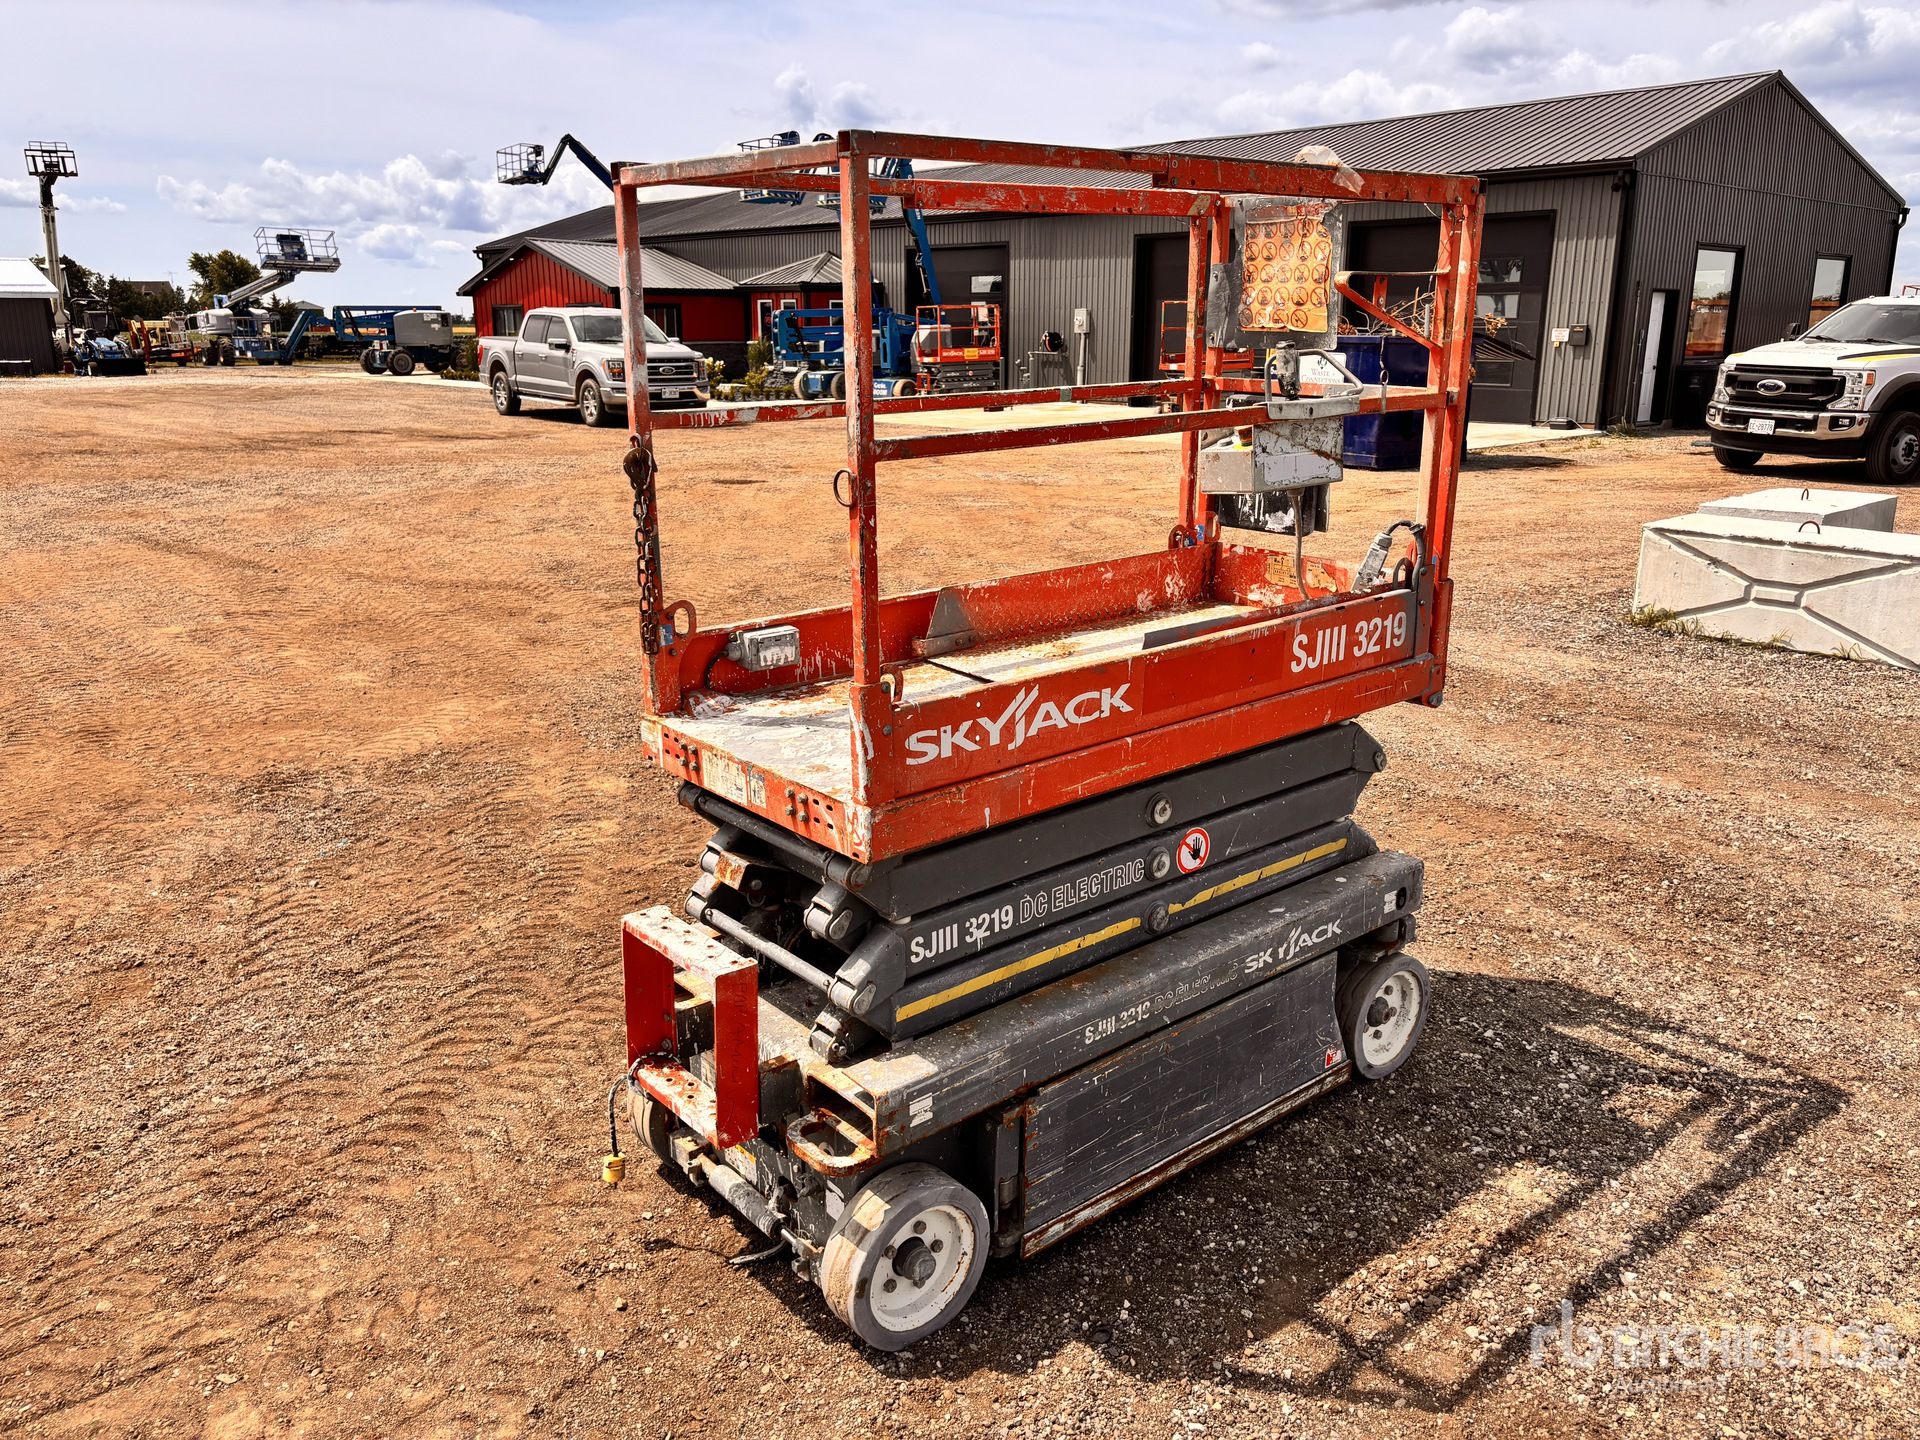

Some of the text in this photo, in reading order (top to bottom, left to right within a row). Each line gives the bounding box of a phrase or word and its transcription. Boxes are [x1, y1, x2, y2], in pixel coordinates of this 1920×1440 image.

[1290, 611, 1407, 673] SJIII 3219
[904, 683, 1134, 766] SKYJACK
[965, 904, 1014, 943] 3219
[1019, 892, 1048, 924] DC
[1051, 858, 1145, 913] ELECTRIC
[1244, 918, 1343, 974] SKYJACK
